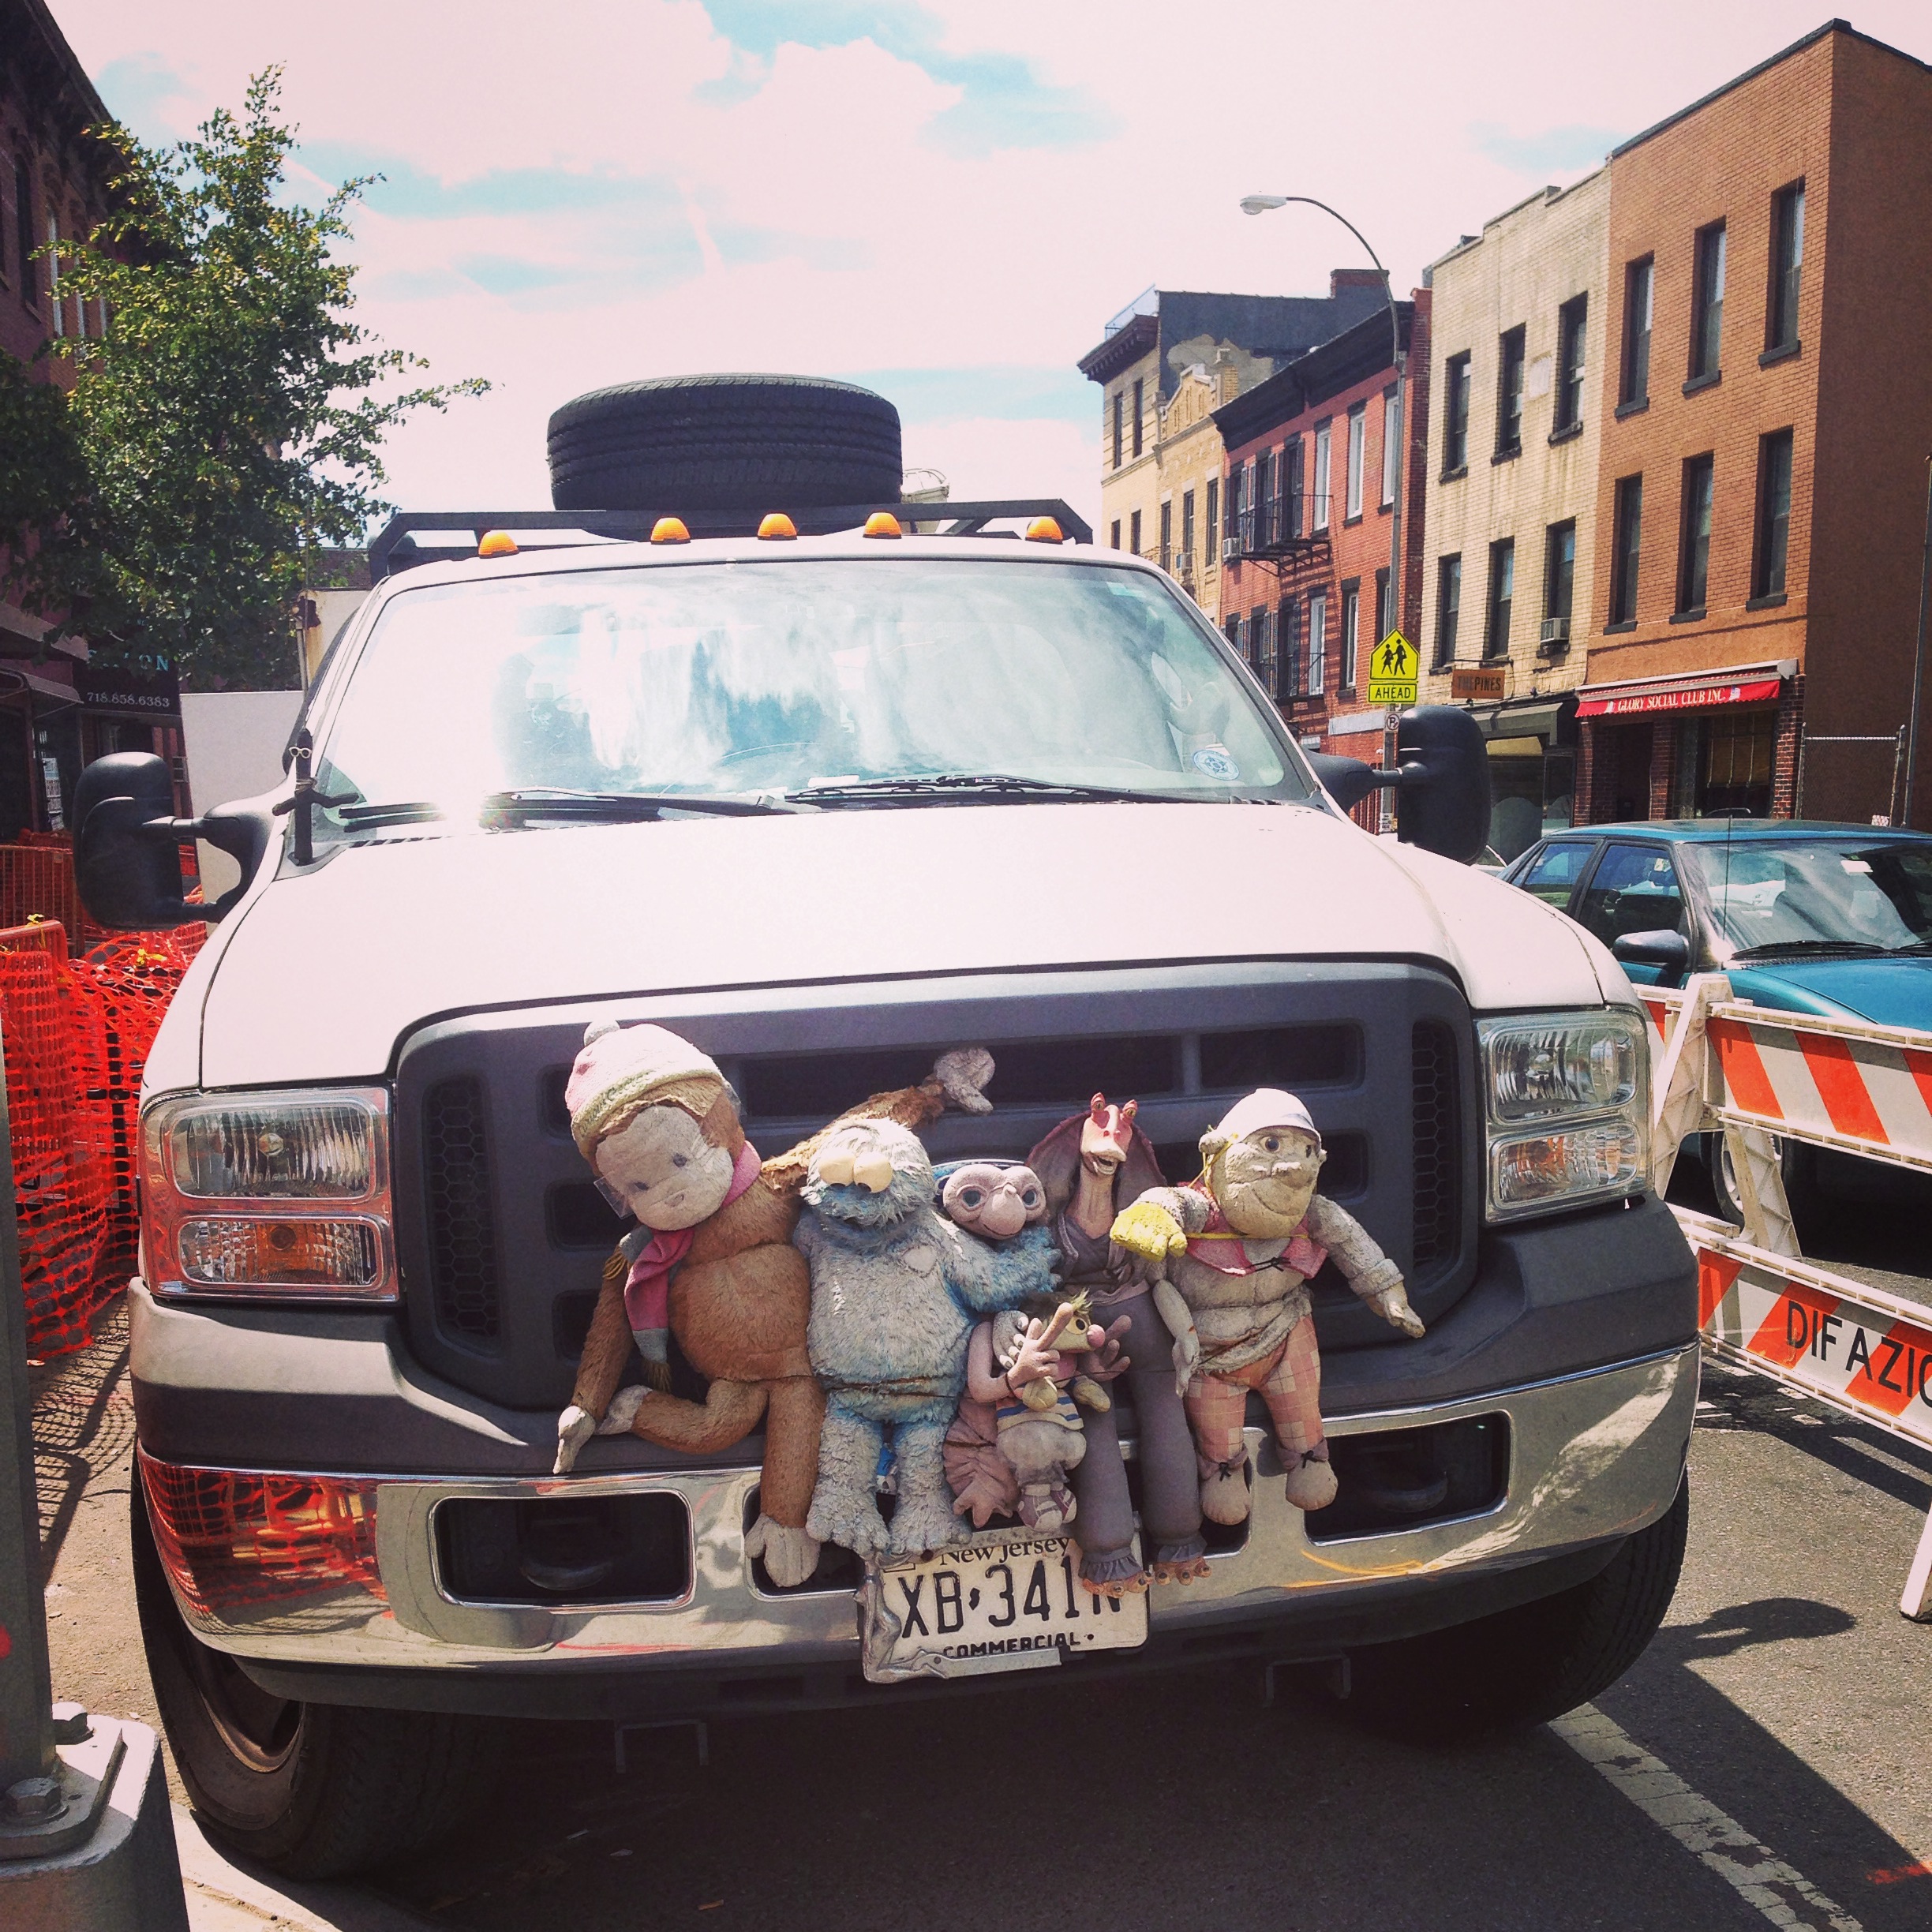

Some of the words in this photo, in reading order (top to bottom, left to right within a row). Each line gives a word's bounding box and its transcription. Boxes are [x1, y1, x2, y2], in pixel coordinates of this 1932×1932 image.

[1375, 687, 1411, 698] AHEAD
[1474, 676, 1501, 691] PINES
[1618, 698, 1645, 712] GLORY
[1646, 693, 1679, 709] SOCIAL
[1682, 690, 1705, 706] CLUB
[1707, 687, 1727, 702] INC.
[940, 1545, 995, 1566] New
[999, 1537, 1072, 1564] Jersey
[942, 1631, 1081, 1658] COMMERCIAL
